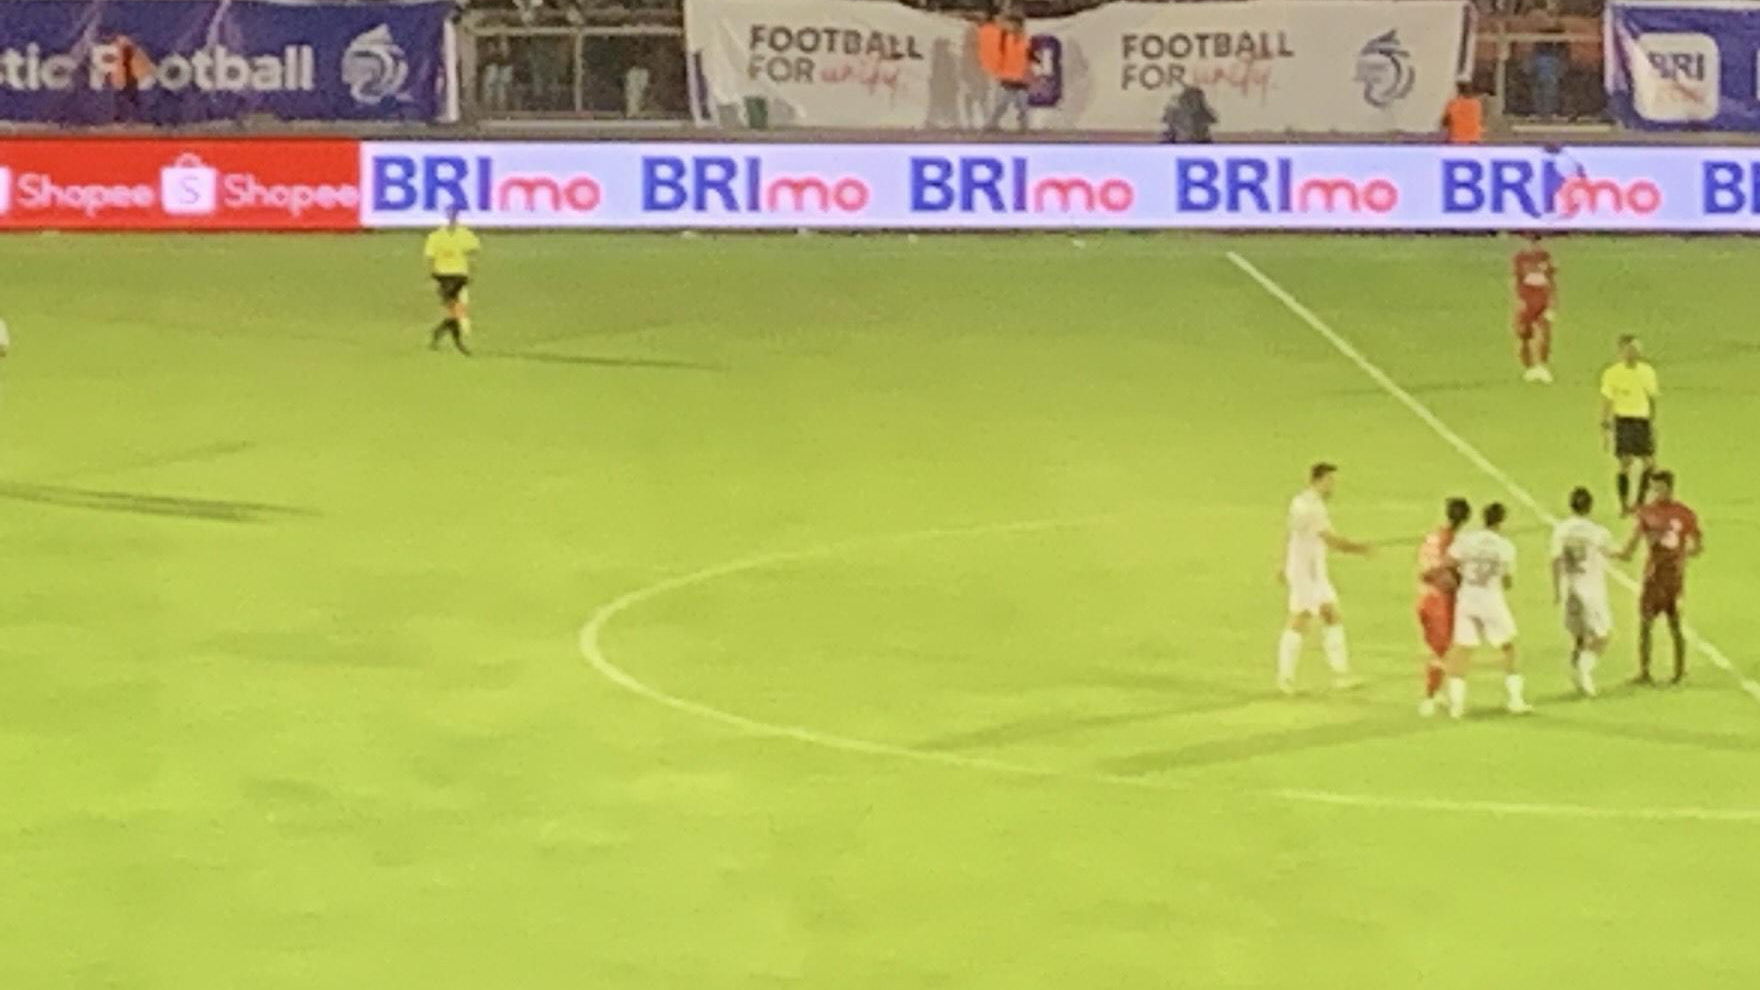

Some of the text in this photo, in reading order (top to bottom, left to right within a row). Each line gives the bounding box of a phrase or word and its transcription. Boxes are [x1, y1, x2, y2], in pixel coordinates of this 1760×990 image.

[750, 24, 924, 59] FOOTBALL
[1121, 33, 1295, 58] FOOTBALL
[0, 42, 76, 90] tic
[748, 57, 815, 84] FOR
[1121, 65, 1187, 90] FOR
[17, 173, 154, 217] Shopee
[224, 173, 359, 216] Shopee
[373, 156, 602, 212] BRImo
[642, 156, 870, 212] BRImo
[910, 156, 1134, 213] BRImo
[1176, 157, 1398, 213] BRImo
[1442, 159, 1661, 218] BRImo
